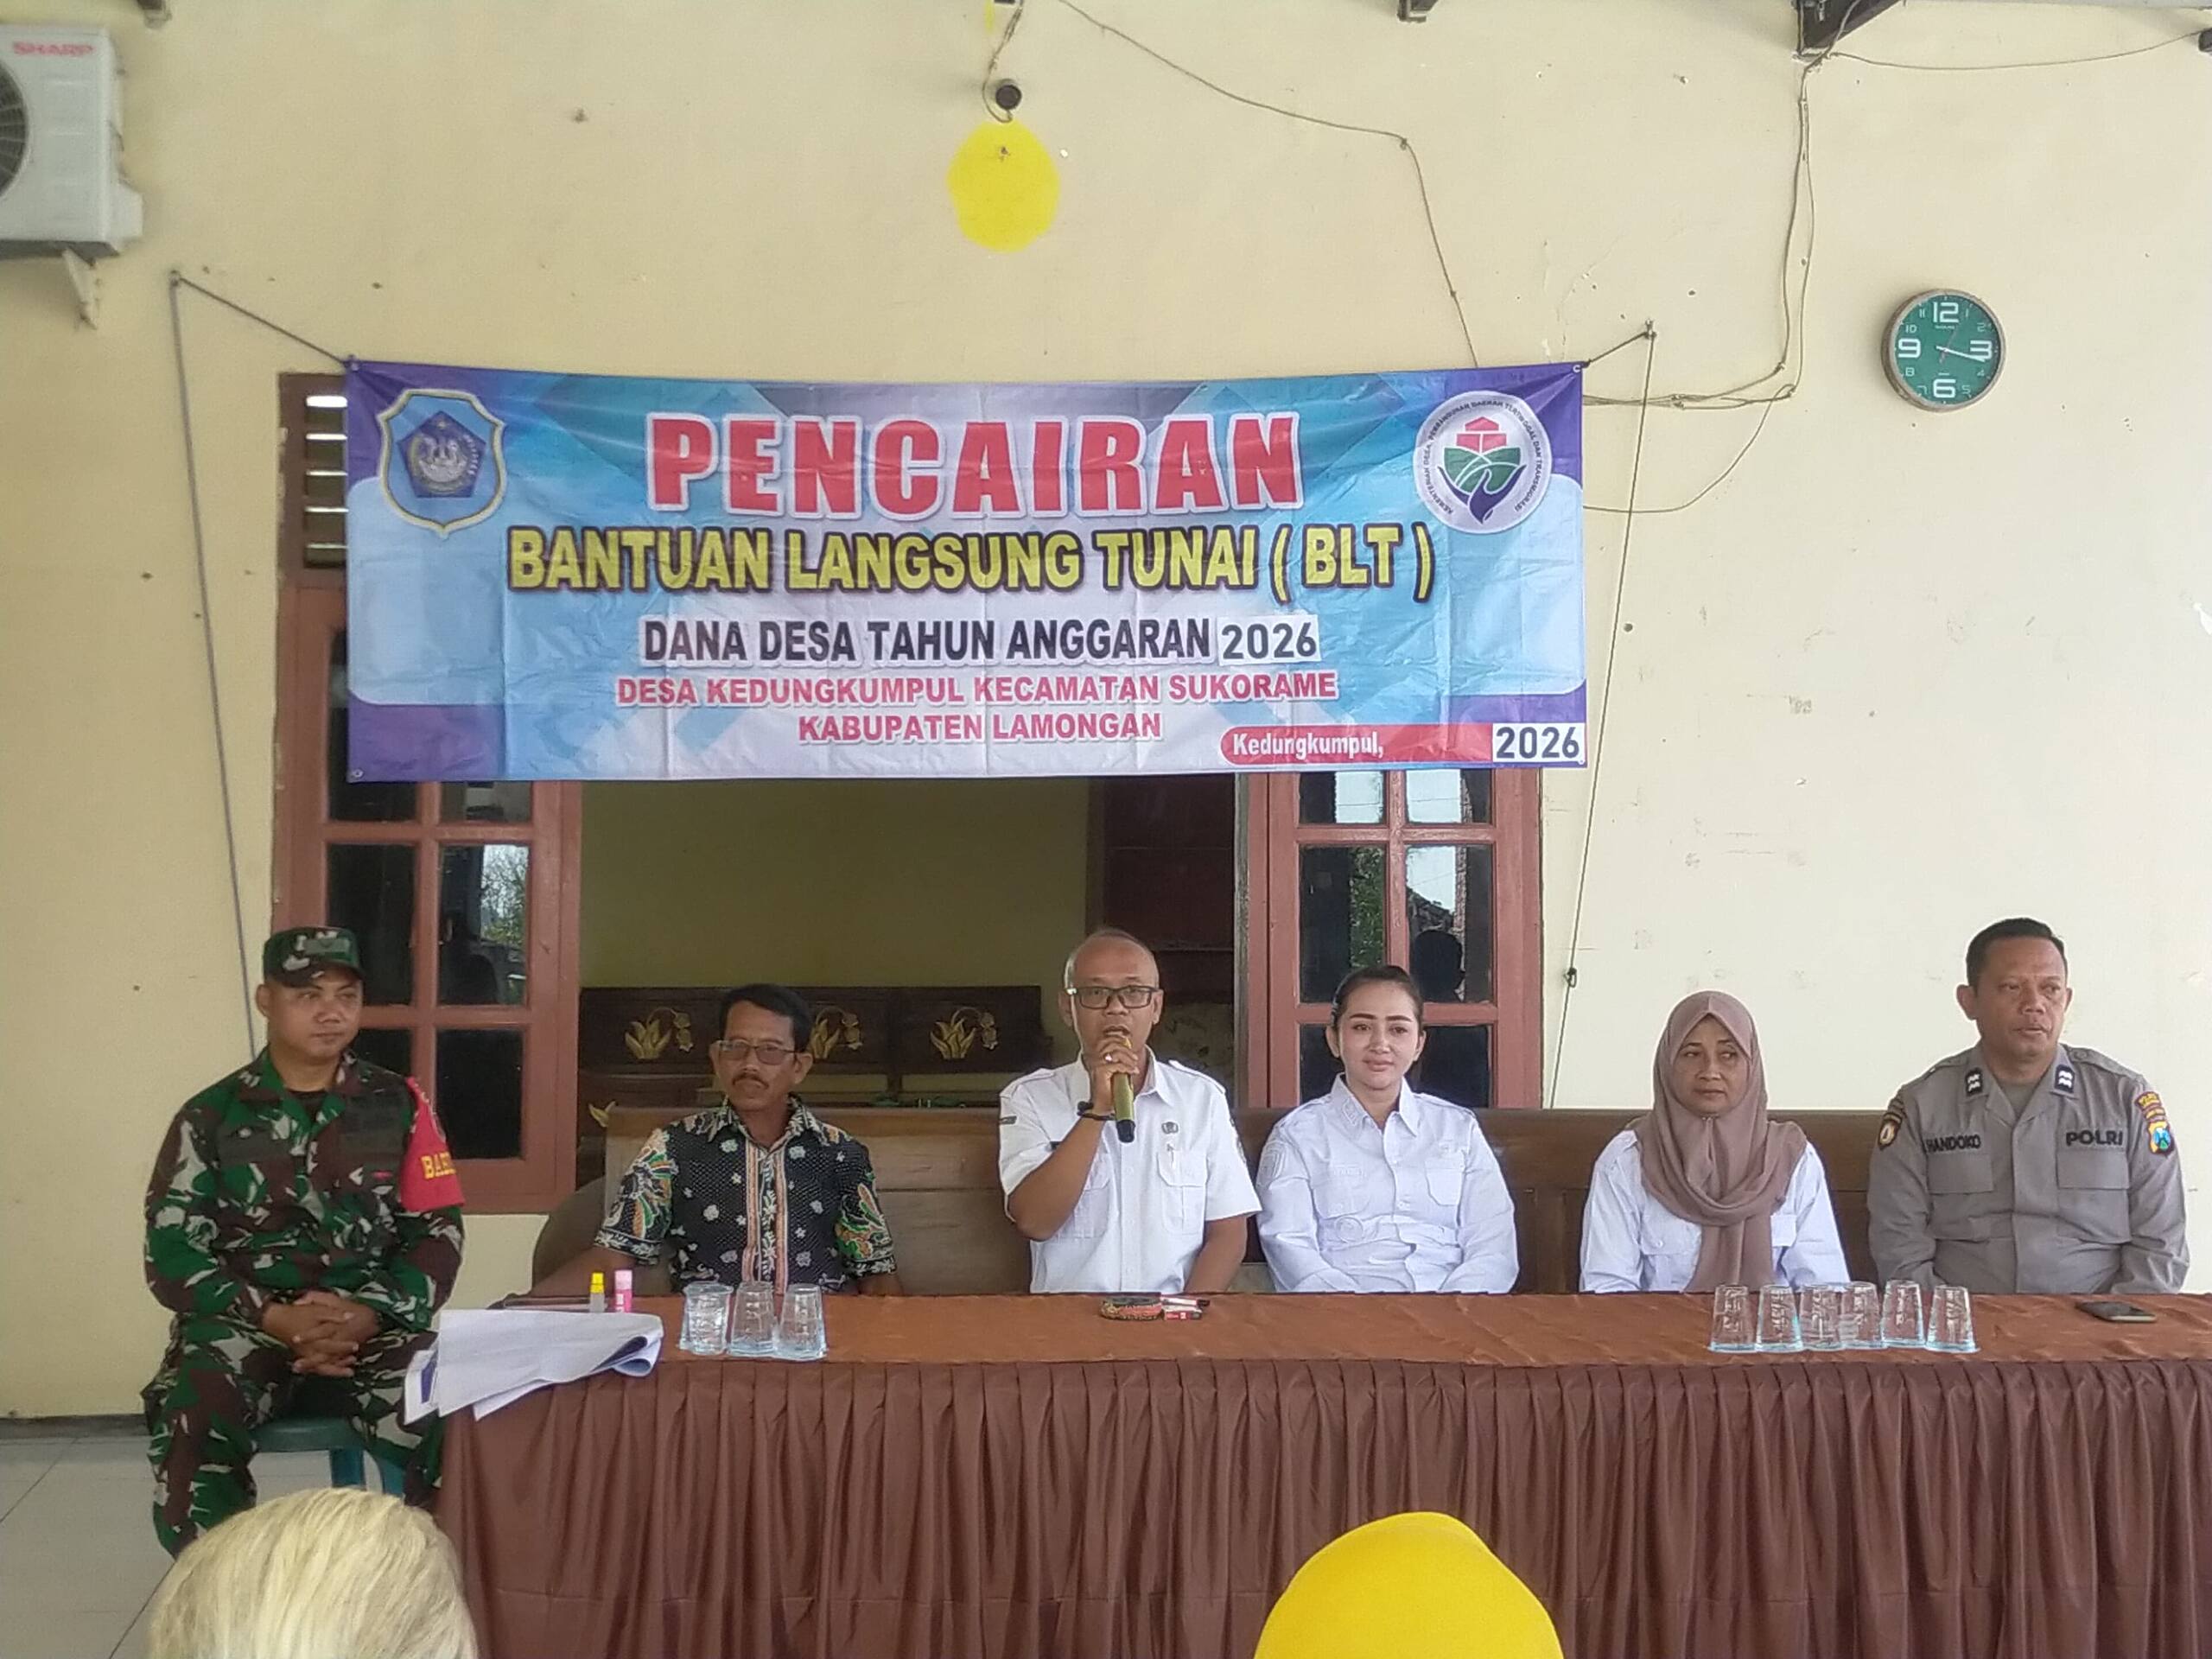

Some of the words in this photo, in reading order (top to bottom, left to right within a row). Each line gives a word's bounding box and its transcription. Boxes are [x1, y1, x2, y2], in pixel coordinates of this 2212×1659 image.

[12, 41, 96, 57] SHARP
[1932, 302, 1959, 322] 12
[1905, 324, 1917, 334] 10
[1976, 322, 1986, 333] 2
[1897, 338, 1921, 358] 9
[1969, 340, 1992, 360] 3
[1904, 367, 1916, 377] 8
[1916, 385, 1927, 395] 7
[1932, 378, 1956, 398] 6
[1961, 385, 1971, 395] 5
[647, 413, 1302, 518] PENCAIRAN
[508, 526, 772, 593] BANTUAN
[785, 530, 1084, 593] LANGSUNG
[1091, 525, 1259, 591] TUNAI
[644, 620, 747, 662] DANA
[760, 620, 856, 662] DESA
[867, 620, 995, 661] TAHUN
[1006, 618, 1211, 660] ANGGARAN
[1221, 621, 1317, 660] 2026
[617, 677, 697, 704] DESA
[706, 677, 965, 704] KEDUNGKUMPUL
[974, 675, 1159, 702] KECAMATAN
[1168, 672, 1337, 701] SUKORAME
[798, 714, 982, 742] KABUPATEN
[993, 712, 1161, 741] LAMONGAN
[1233, 731, 1383, 760] Kedungkumpul,
[1495, 726, 1580, 760] 2026
[2066, 1129, 2123, 1147] POLRI
